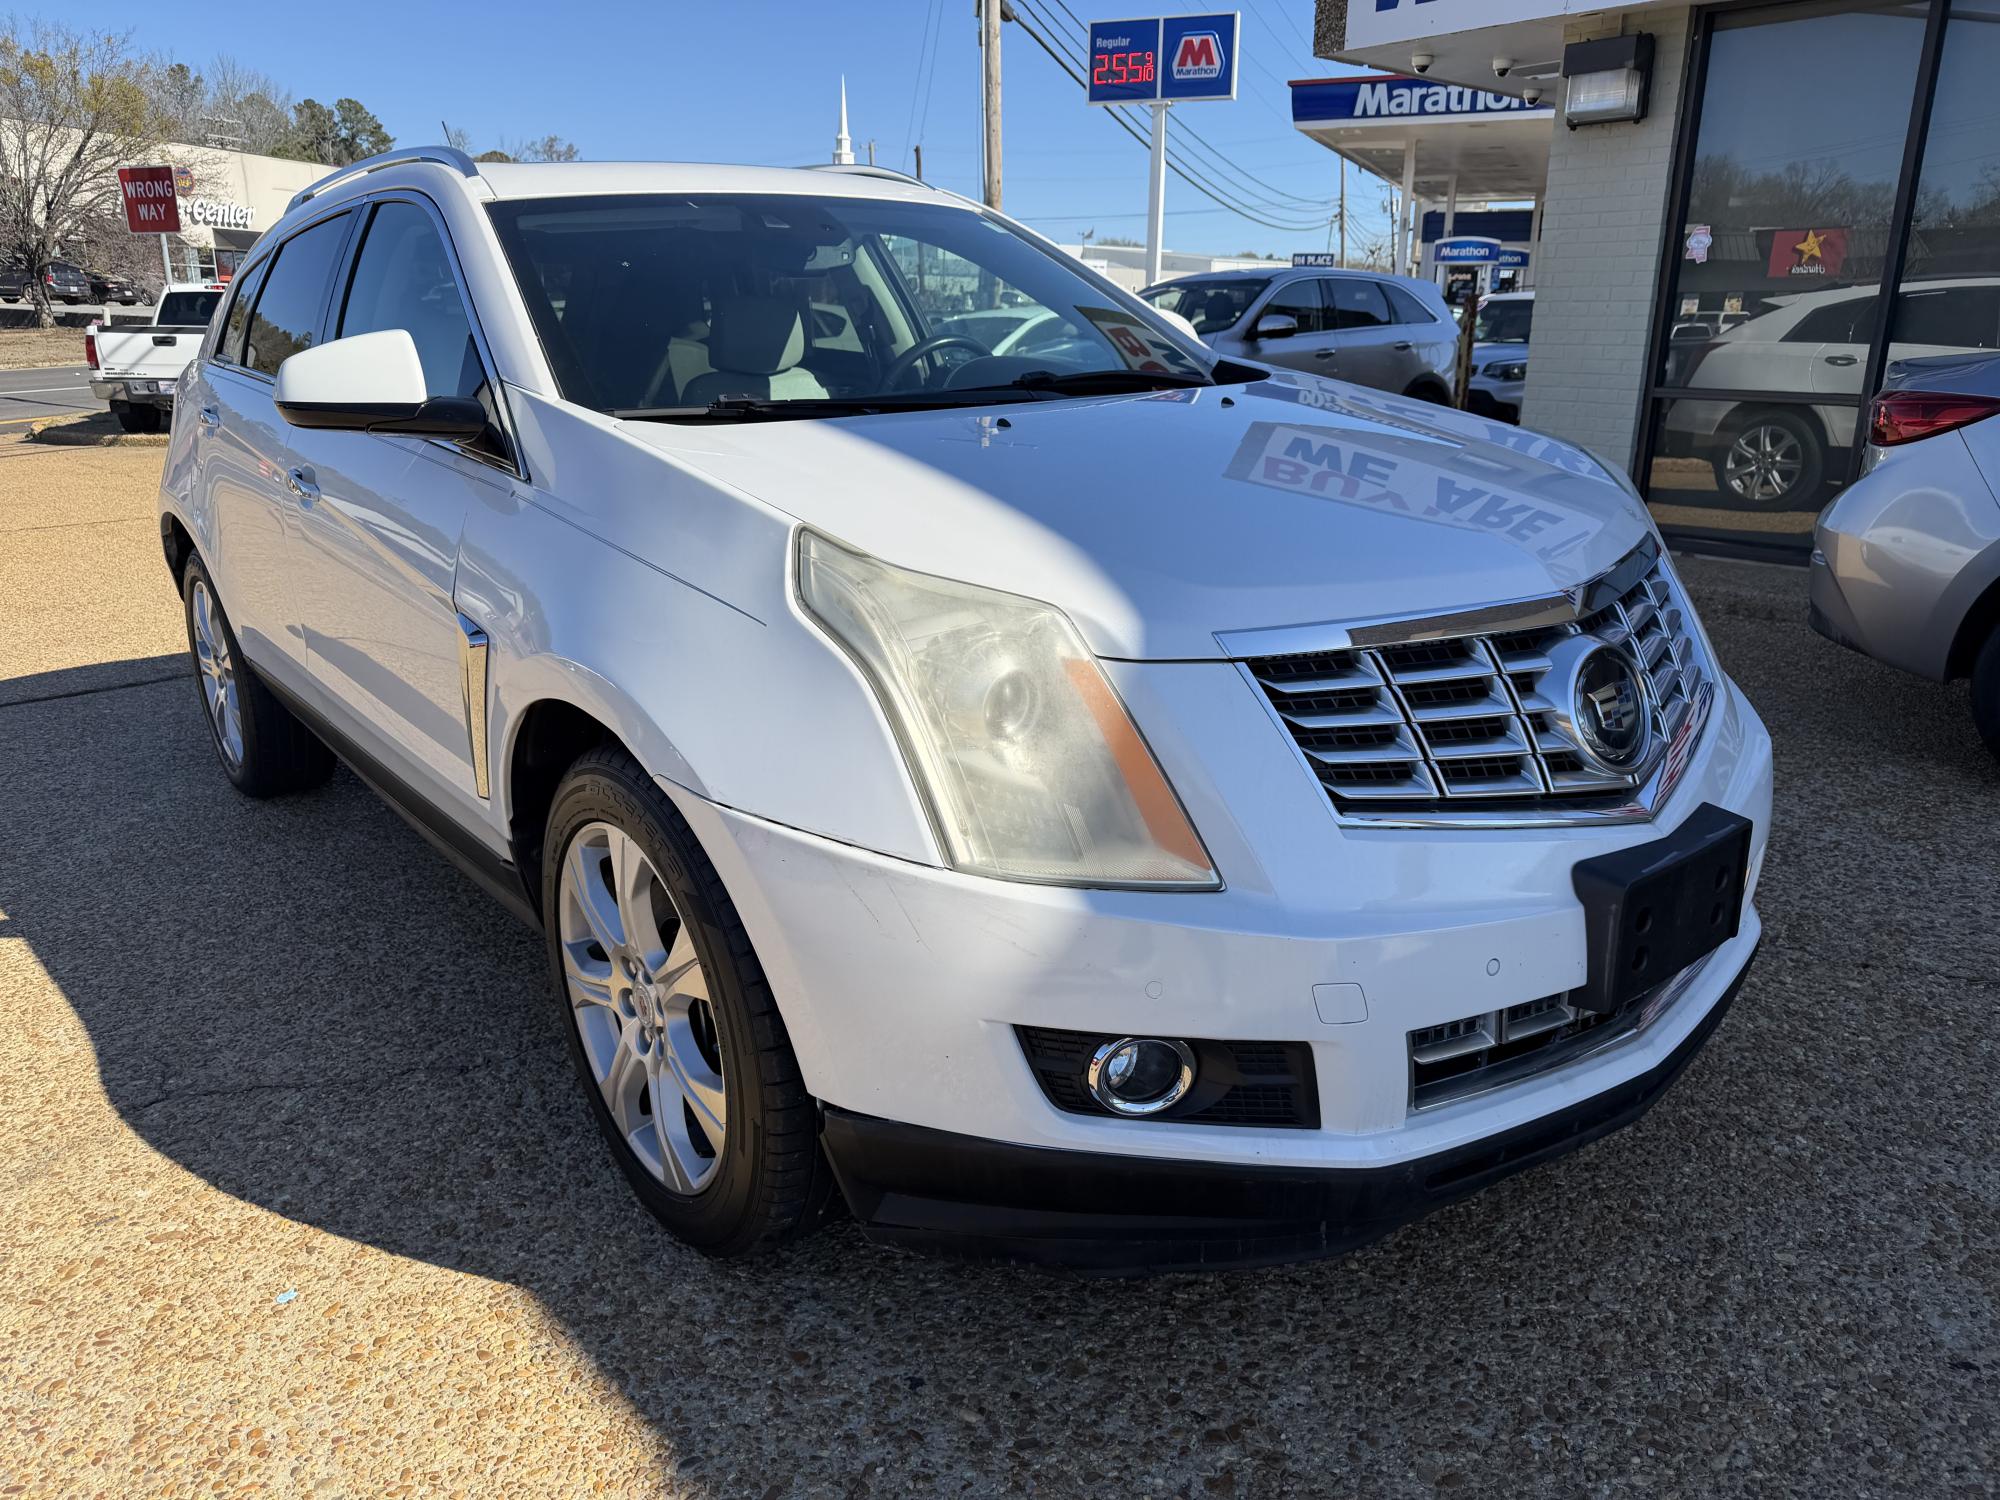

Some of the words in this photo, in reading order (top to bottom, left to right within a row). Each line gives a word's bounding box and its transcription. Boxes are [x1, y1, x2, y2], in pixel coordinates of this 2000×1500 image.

[1096, 37, 1131, 49] Regular
[1176, 67, 1217, 76] Marathon
[124, 180, 173, 199] WRONG
[138, 204, 166, 221] WAY
[1440, 246, 1490, 257] Marathon
[1307, 255, 1332, 265] PLACE
